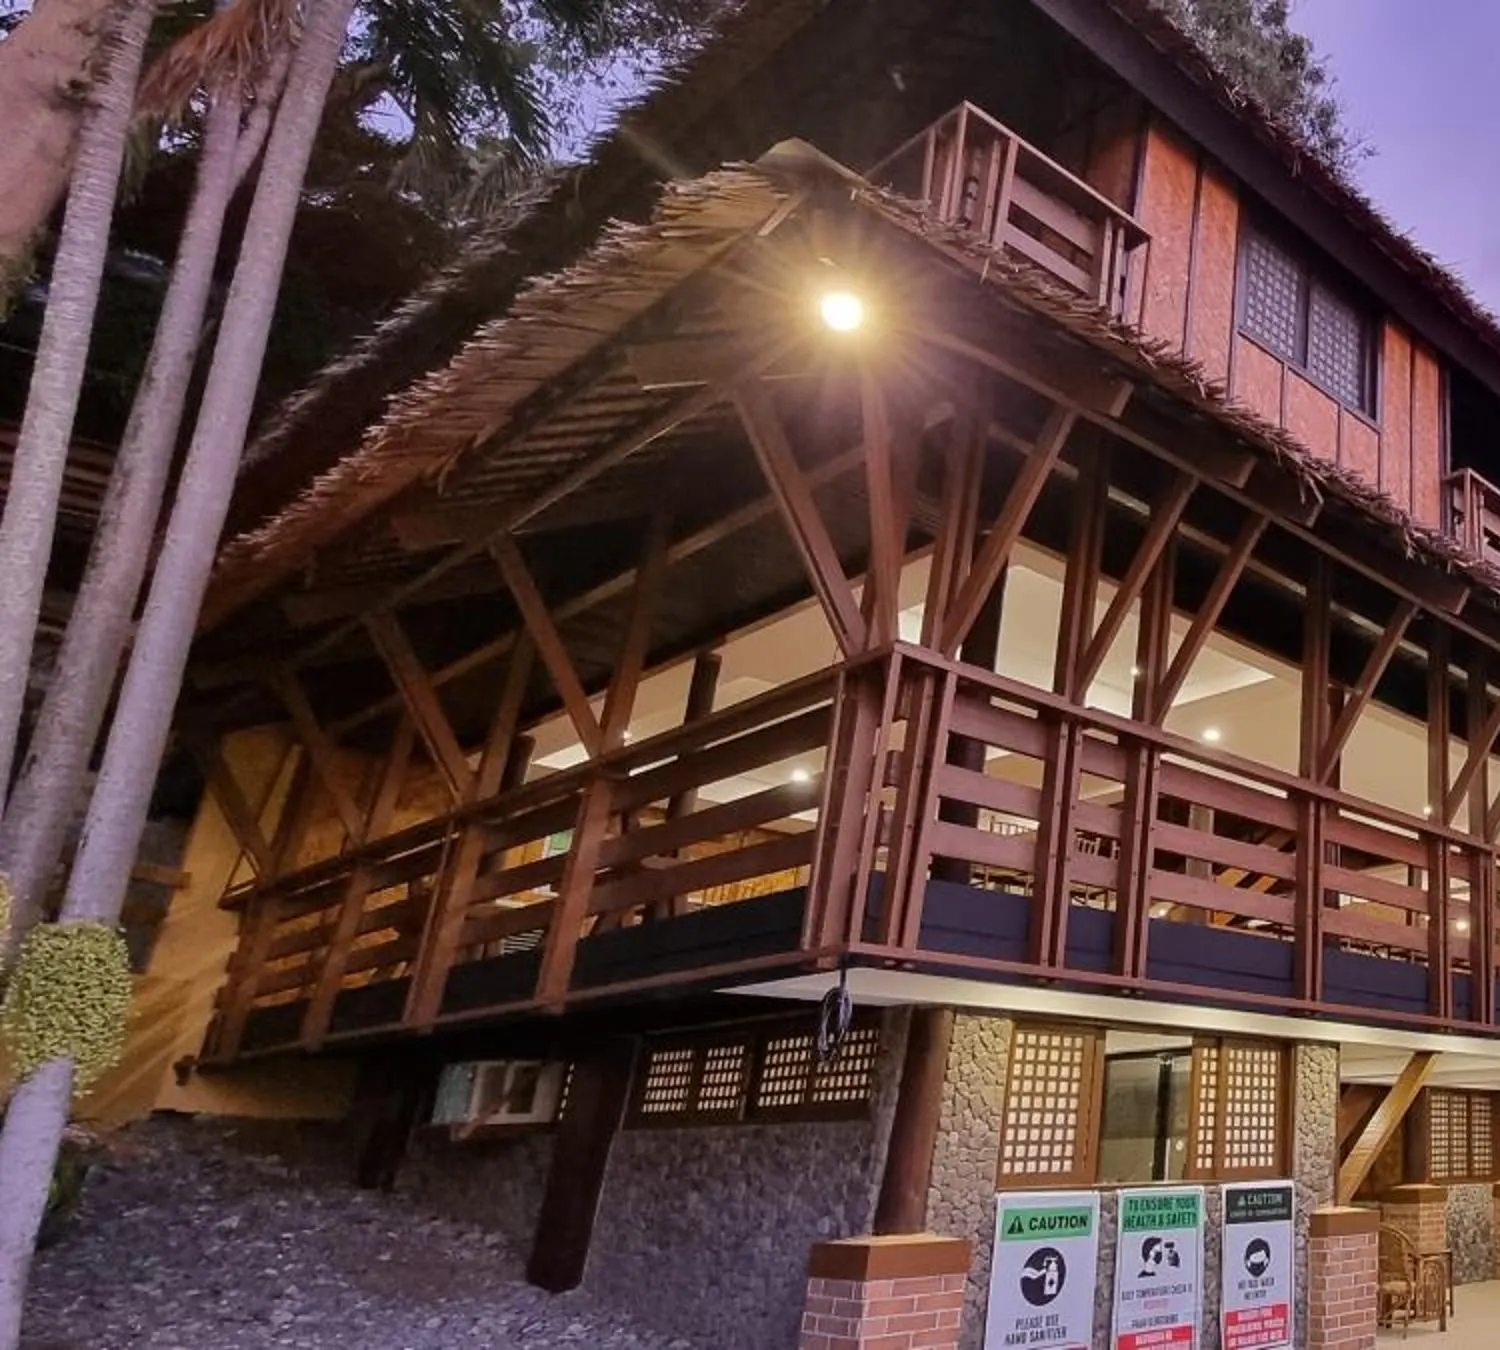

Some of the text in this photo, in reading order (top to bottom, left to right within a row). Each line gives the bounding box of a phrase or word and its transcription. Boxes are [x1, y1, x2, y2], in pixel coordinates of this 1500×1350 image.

[1029, 1215, 1088, 1231] CAUTION
[1124, 1214, 1156, 1229] HEALTH
[1167, 1211, 1197, 1225] SAFETY
[1016, 1316, 1043, 1330] PLEASE
[1005, 1327, 1067, 1345] HAND SANITIZER
